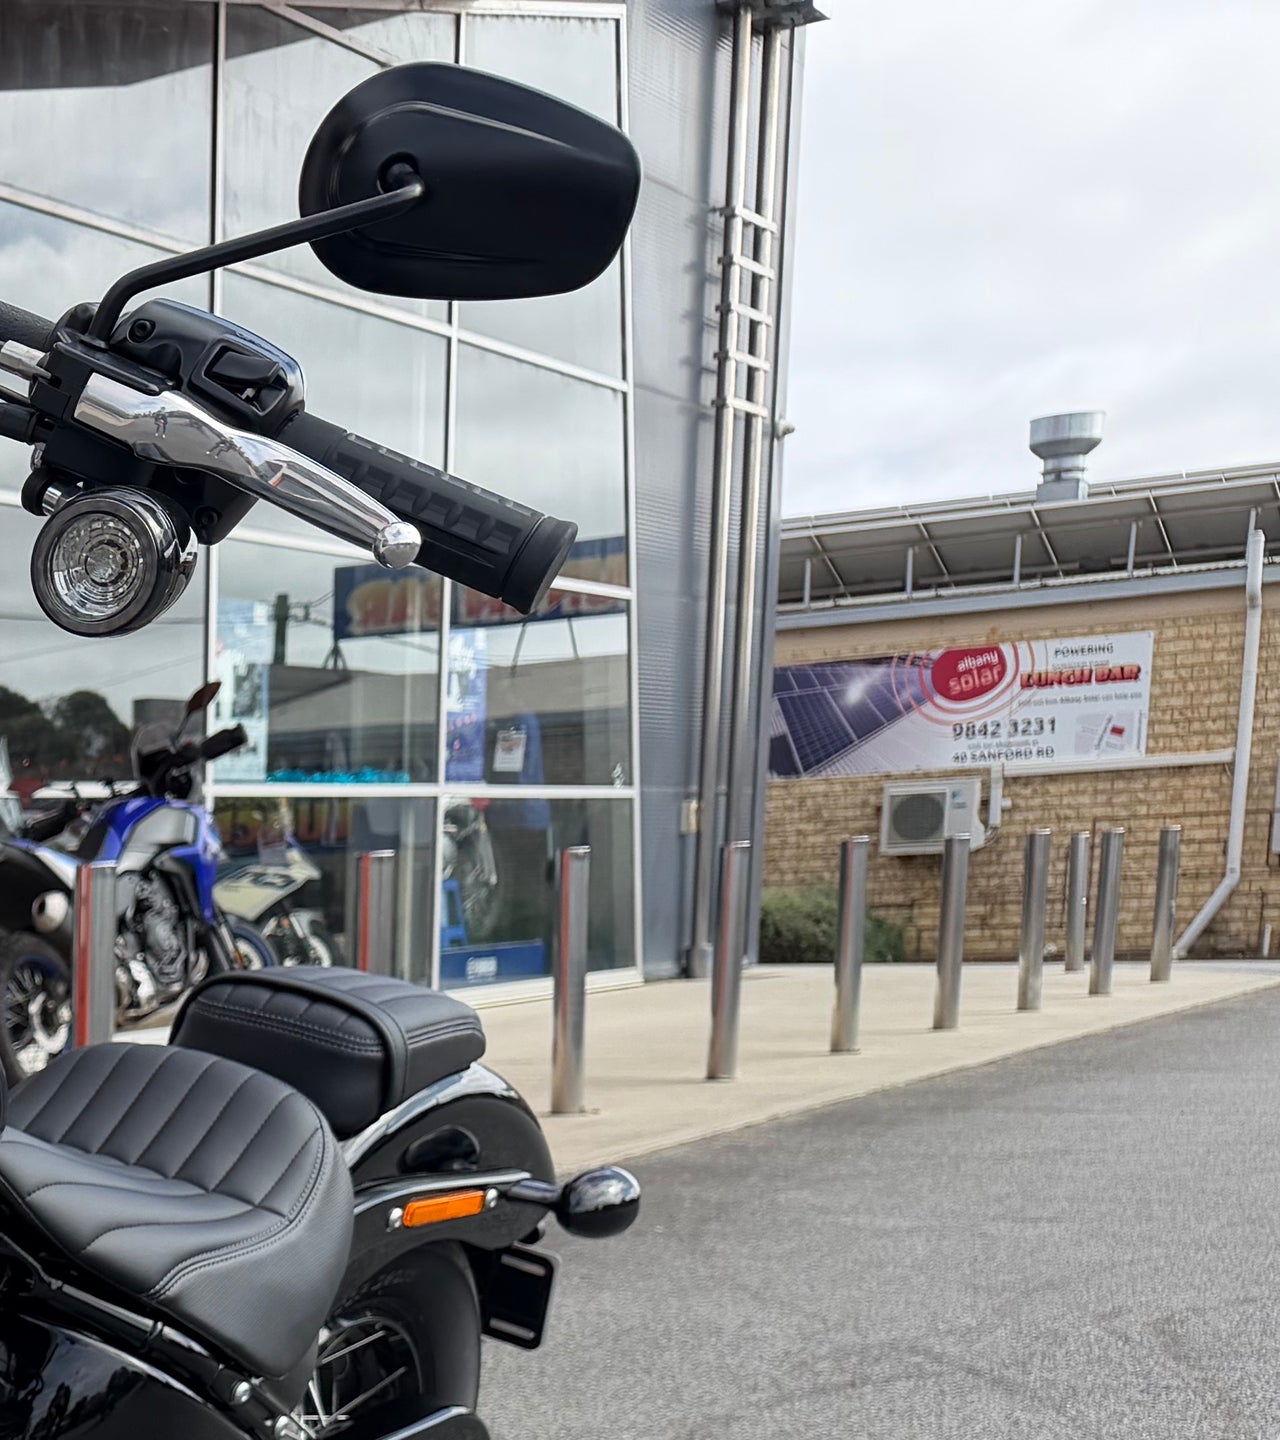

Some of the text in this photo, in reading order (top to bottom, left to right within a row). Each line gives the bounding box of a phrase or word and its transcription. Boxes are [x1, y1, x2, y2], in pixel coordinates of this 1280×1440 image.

[957, 650, 998, 673] albany
[1054, 643, 1114, 658] POWERING
[948, 667, 1002, 695] solar
[1020, 669, 1093, 689] LUNCH
[1095, 664, 1142, 684] BAR
[952, 716, 1056, 741] 9842 3231
[970, 748, 1033, 763] SANFORD
[1036, 746, 1055, 759] RD
